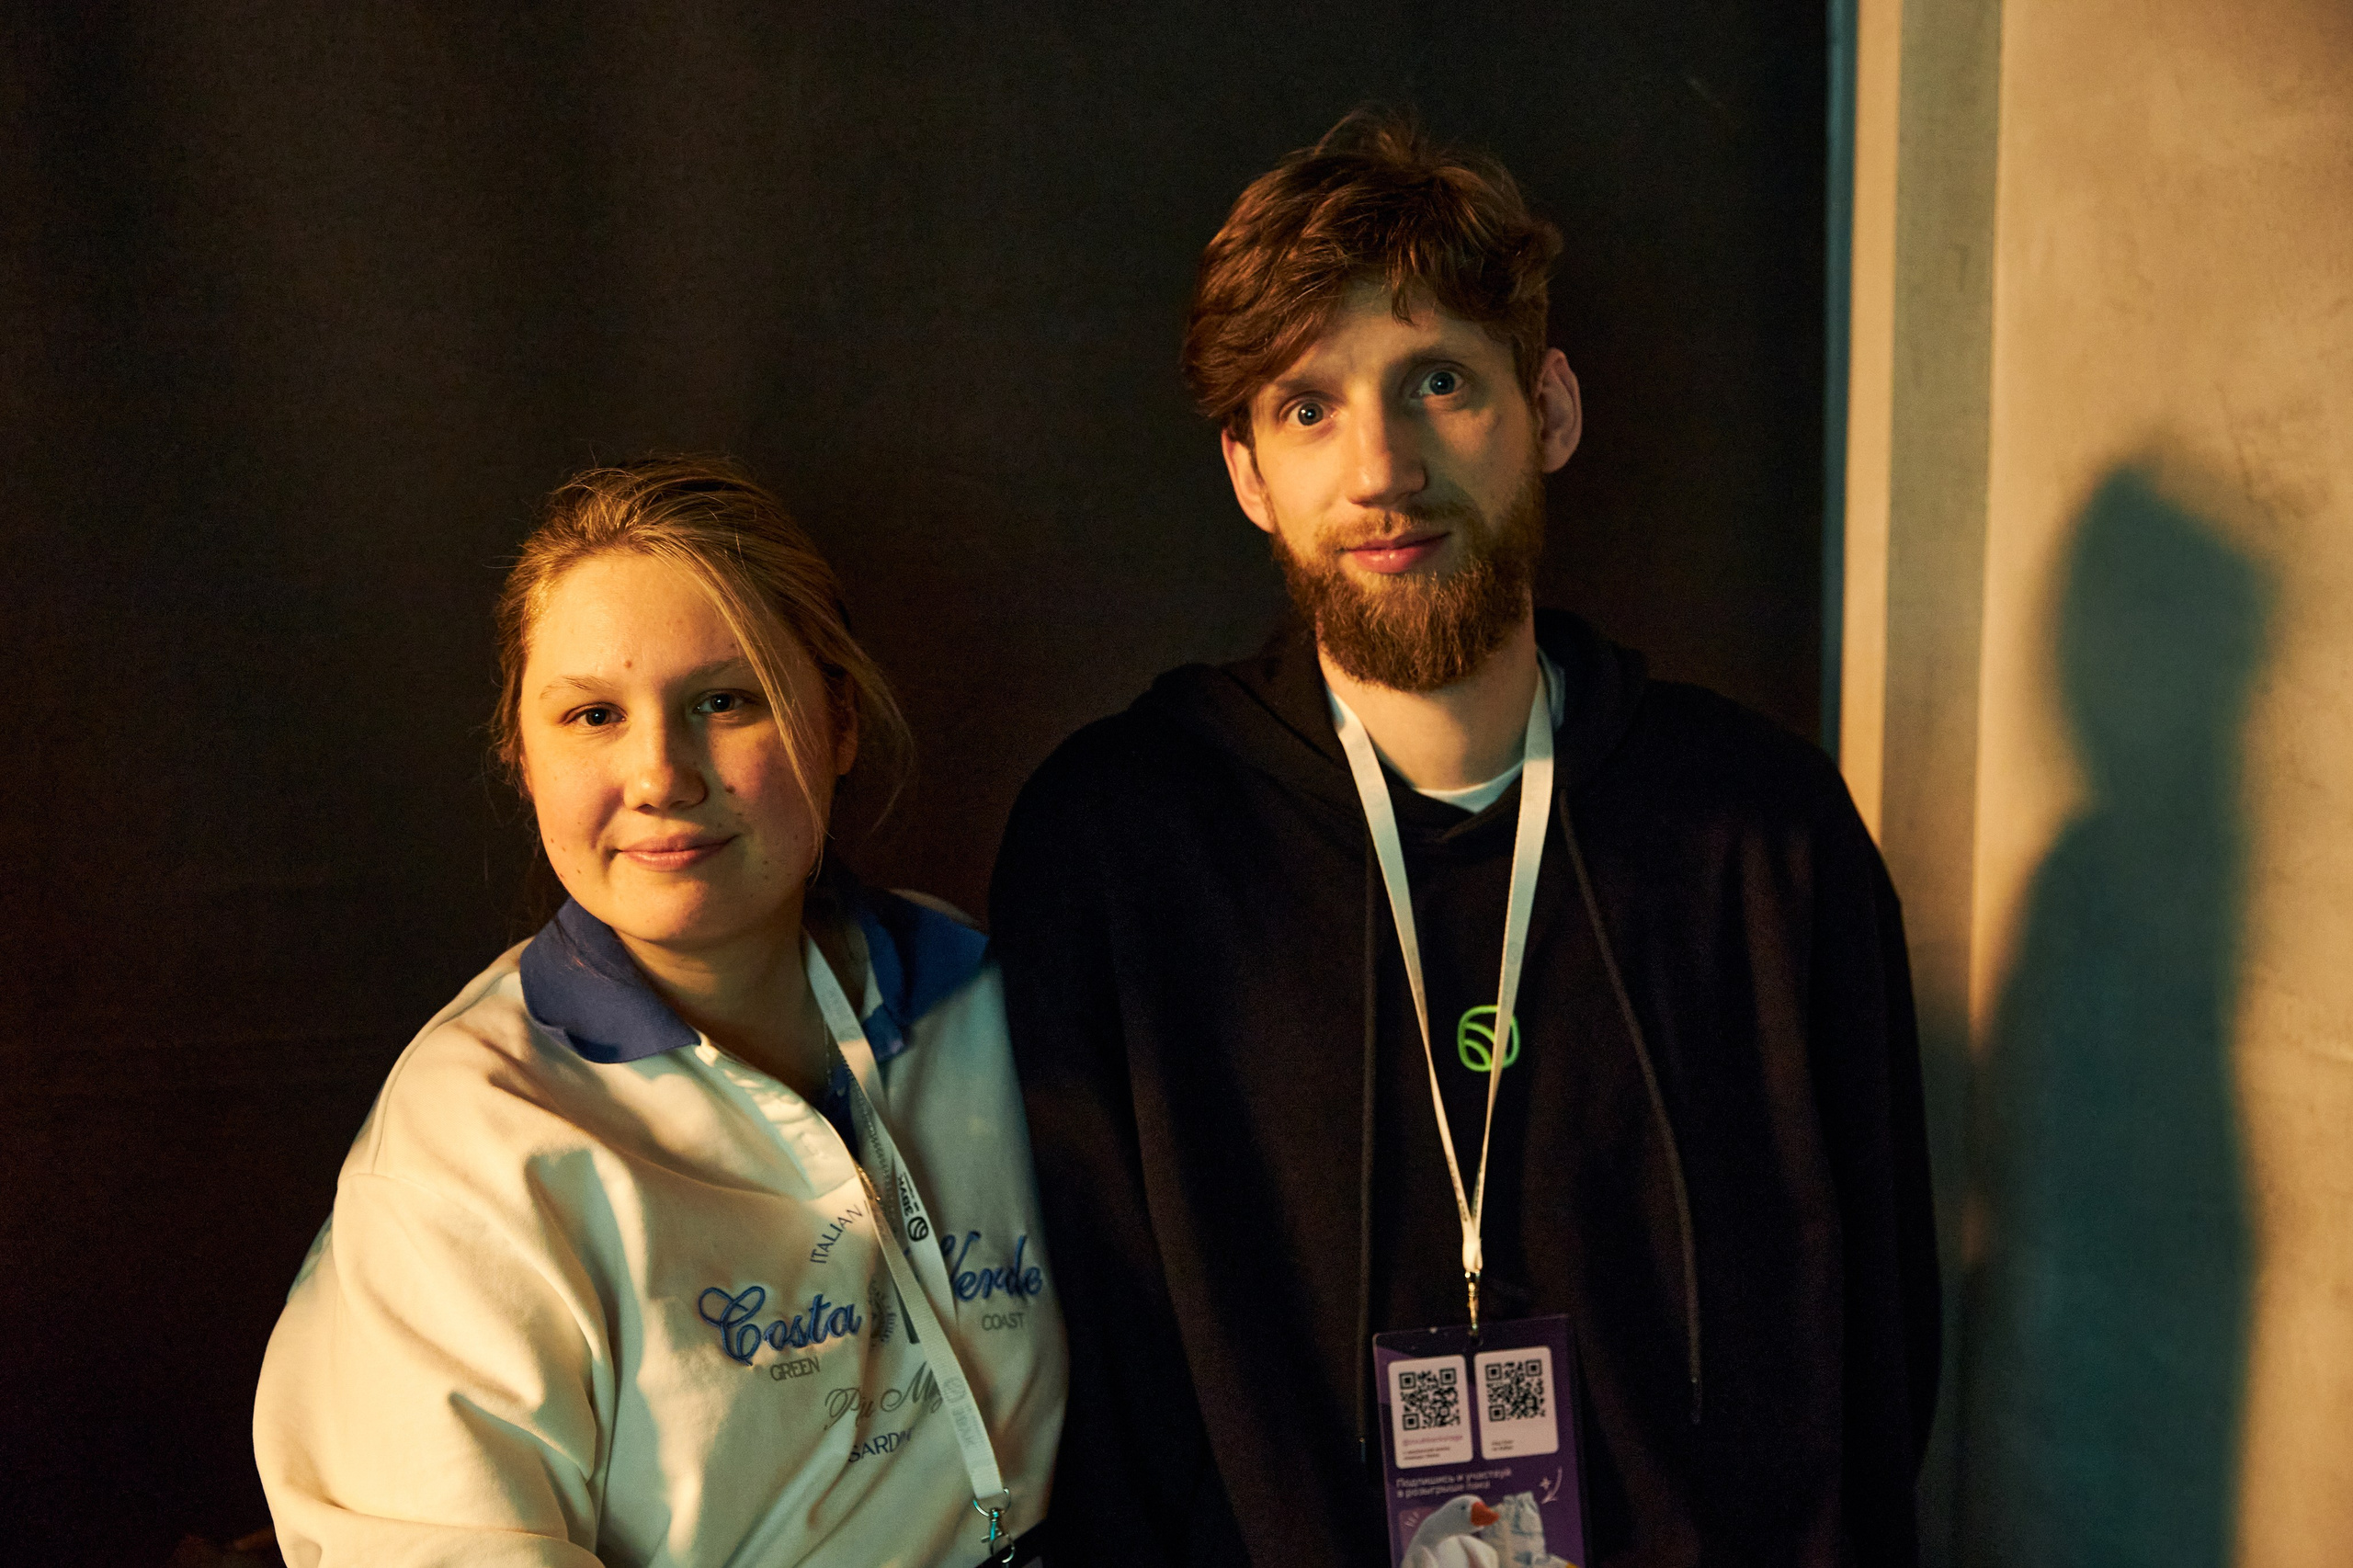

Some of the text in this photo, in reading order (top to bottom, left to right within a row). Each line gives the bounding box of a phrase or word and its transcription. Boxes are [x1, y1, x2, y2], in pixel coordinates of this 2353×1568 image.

[810, 1204, 863, 1264] ITALIAN
[699, 1286, 862, 1366] Costa
[770, 1312, 1025, 1381] GREEN COAST
